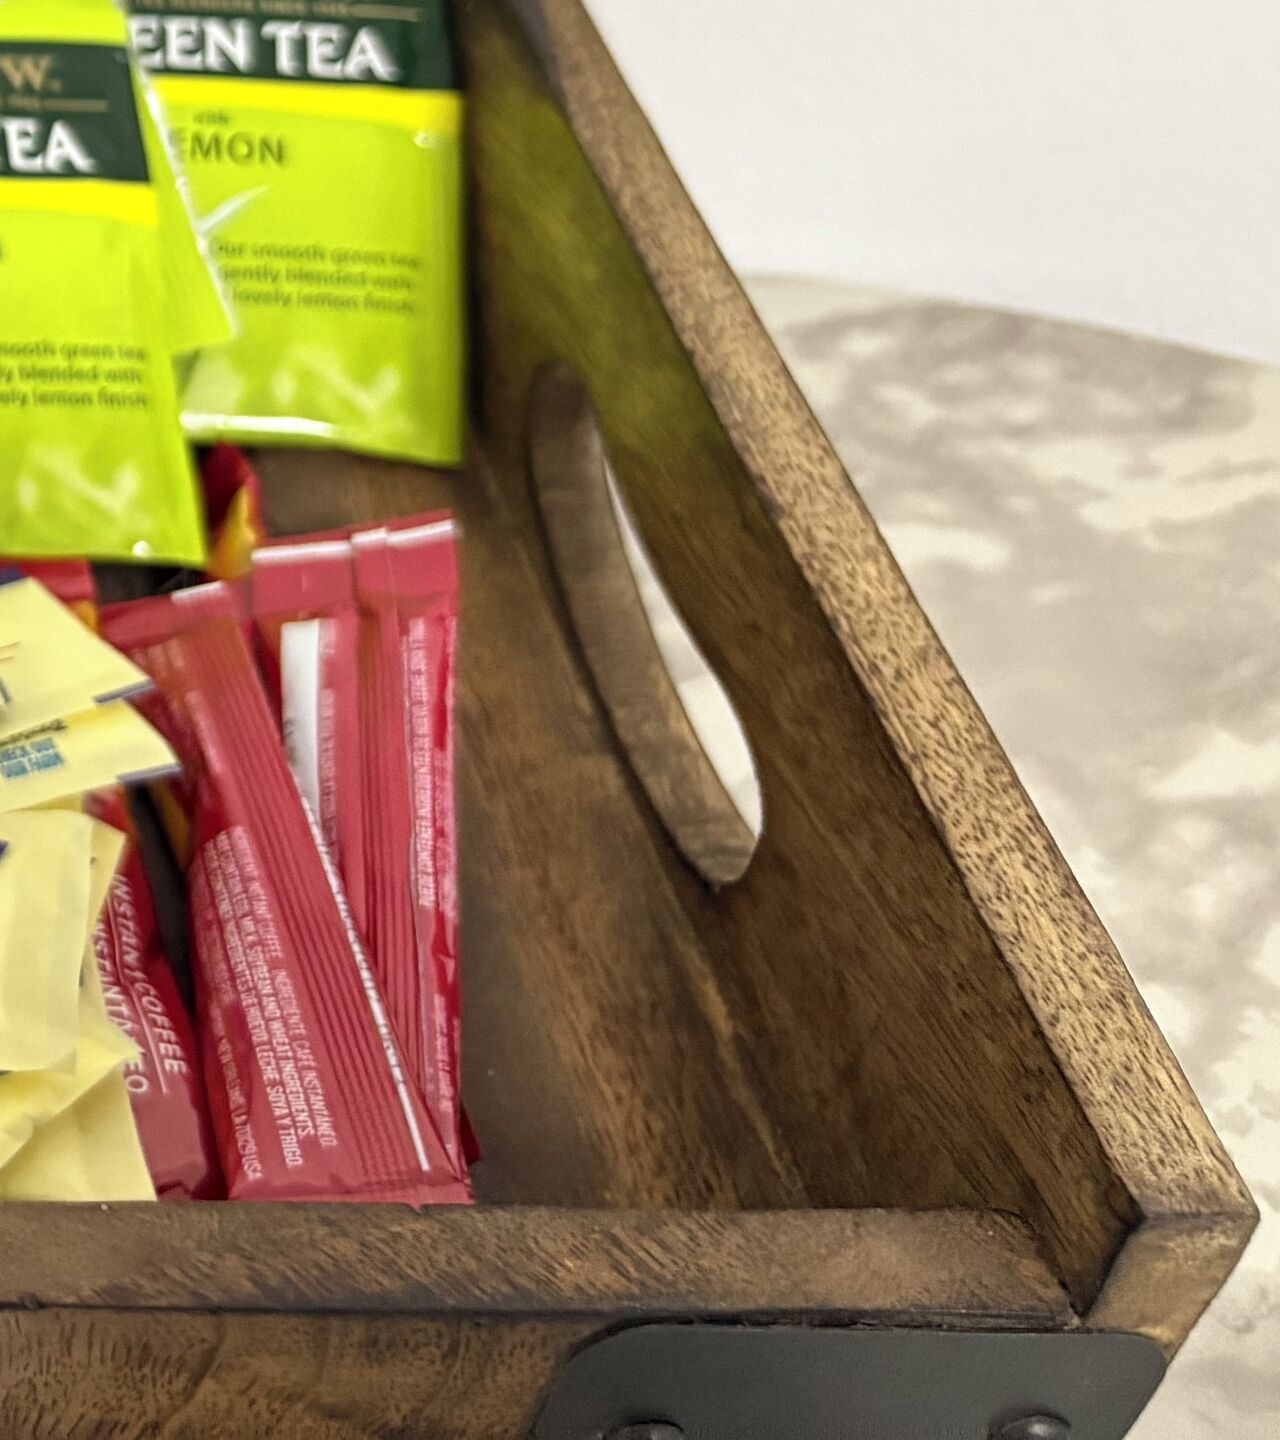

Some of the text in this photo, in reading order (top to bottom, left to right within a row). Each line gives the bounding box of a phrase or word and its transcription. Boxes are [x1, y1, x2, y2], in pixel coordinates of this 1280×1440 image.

[129, 14, 402, 83] EEN TEA
[168, 126, 286, 167] EMON
[113, 872, 189, 1075] INSTANT COFFEE
[246, 945, 274, 995] SOYBEAN
[261, 994, 281, 1019] AND
[239, 989, 257, 1006] DE
[265, 1083, 289, 1117] SOYA
[267, 1018, 293, 1059] WHEAT
[241, 1153, 264, 1183] USA
